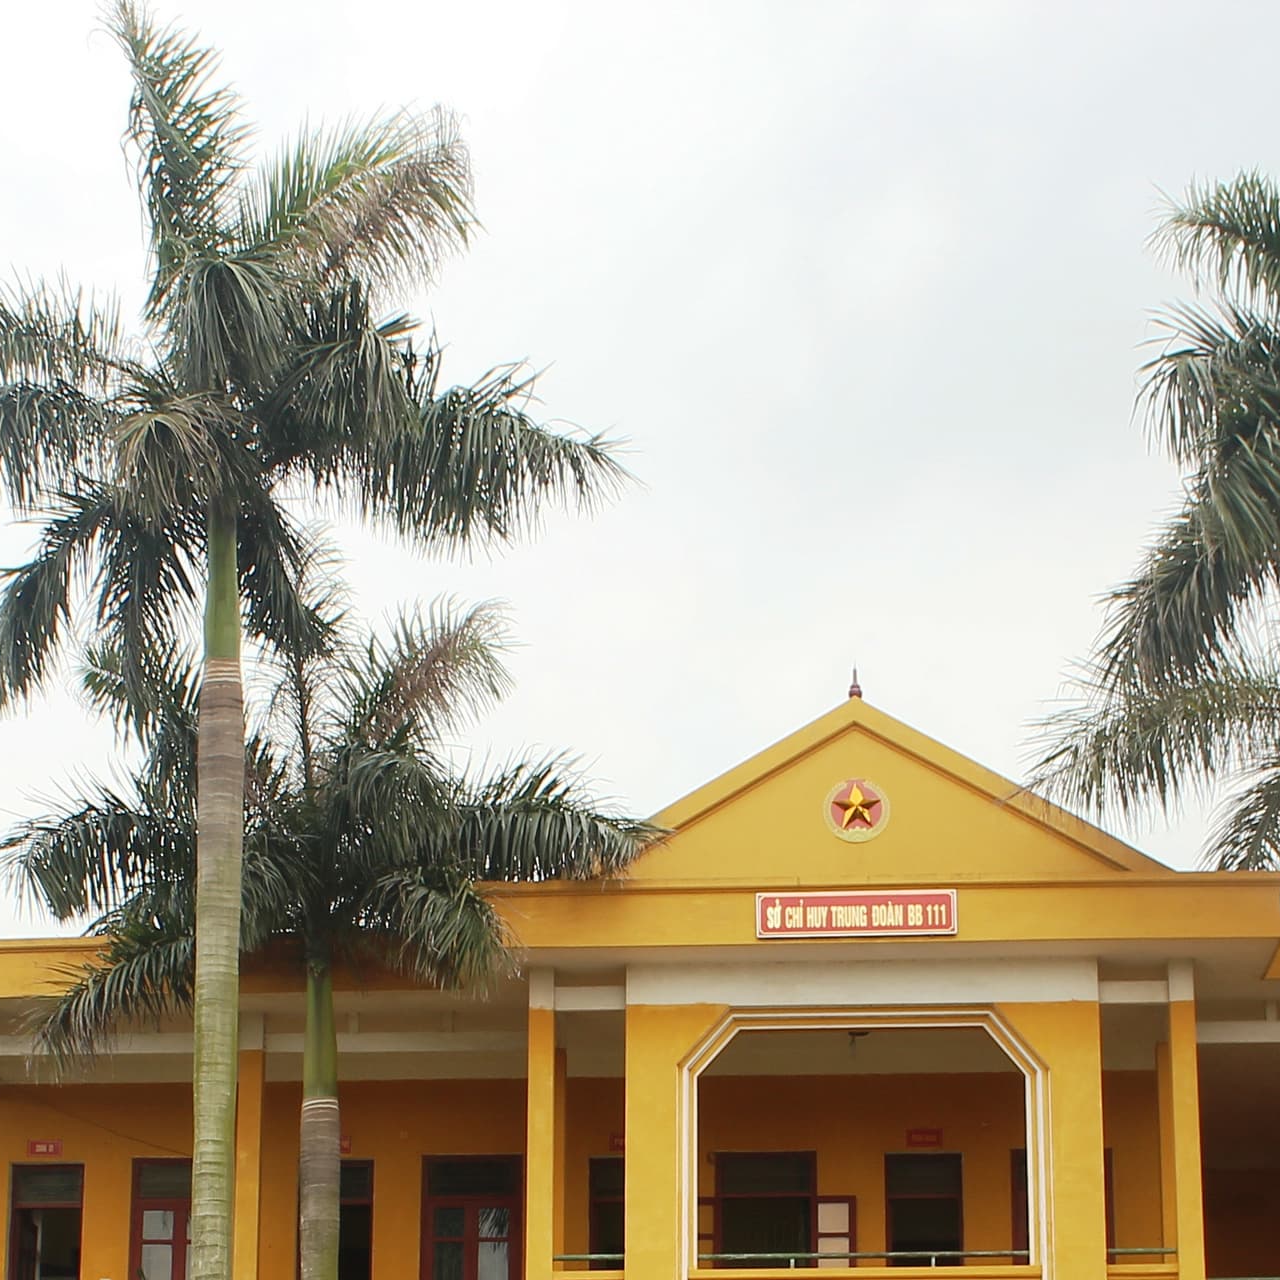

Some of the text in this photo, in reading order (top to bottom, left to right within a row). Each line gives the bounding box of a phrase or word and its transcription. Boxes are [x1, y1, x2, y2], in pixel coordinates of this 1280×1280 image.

[766, 898, 946, 929] SỞ CHỈ HUY TRUNG ĐOÀN BB 111
